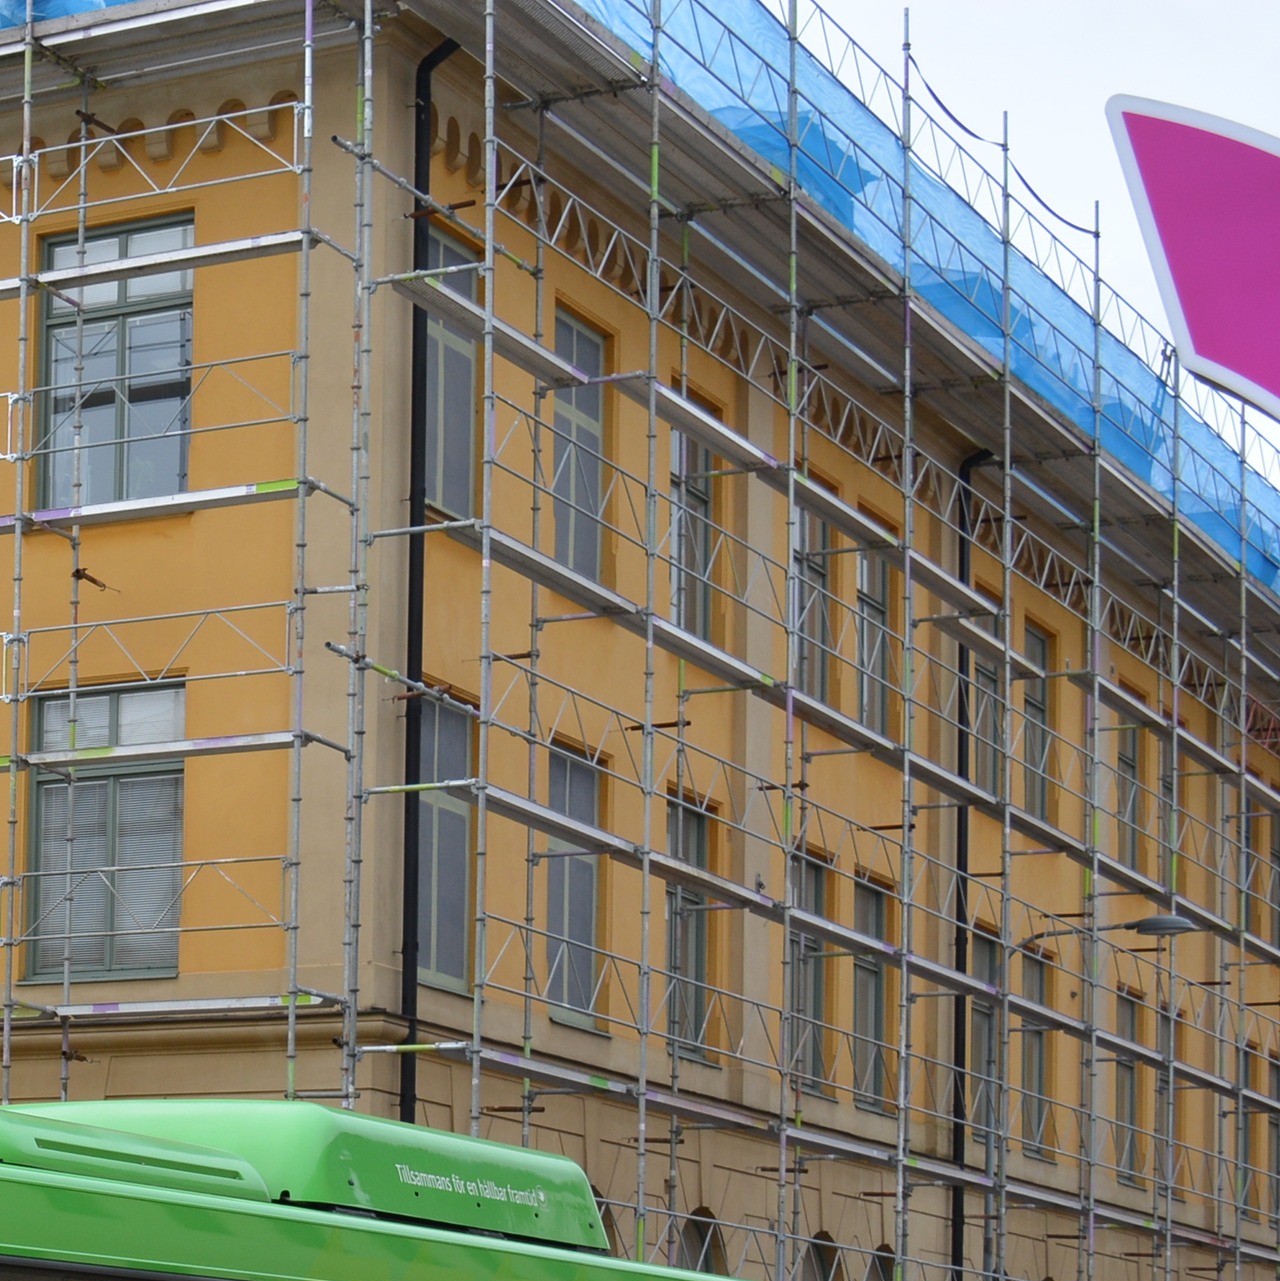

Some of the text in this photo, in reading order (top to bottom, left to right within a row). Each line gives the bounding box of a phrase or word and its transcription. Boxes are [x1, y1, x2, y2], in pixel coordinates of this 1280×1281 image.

[395, 1163, 452, 1192] Tillsammans
[451, 1174, 465, 1194] för
[467, 1181, 478, 1196] en
[508, 1184, 539, 1206] framtid
